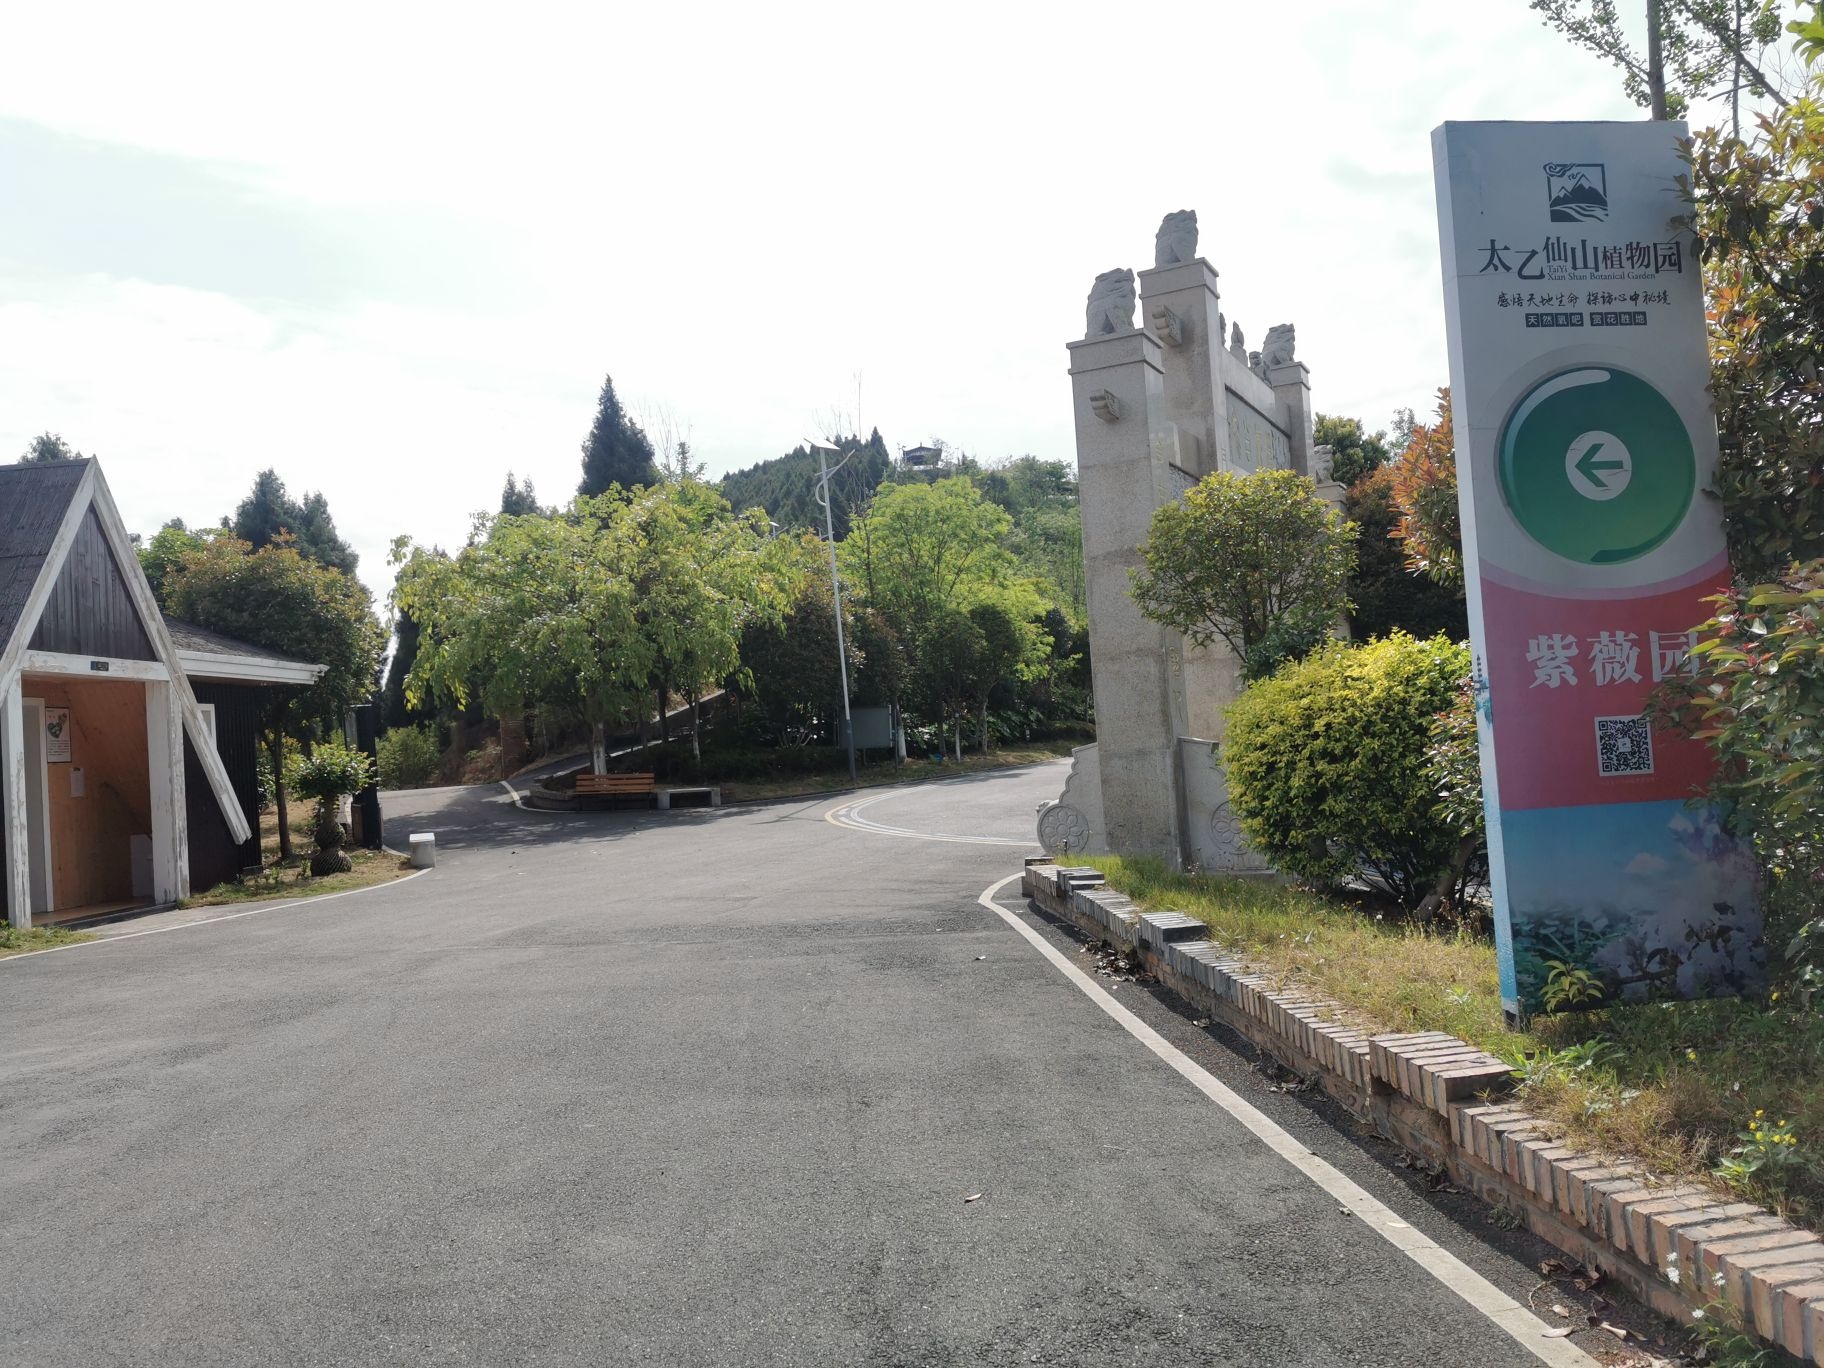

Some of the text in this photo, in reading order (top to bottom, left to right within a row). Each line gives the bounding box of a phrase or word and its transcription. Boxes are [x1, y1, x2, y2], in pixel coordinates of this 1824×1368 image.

[1478, 236, 1682, 280] 太乙仙山植物园
[1547, 264, 1568, 273] TaiYi
[1547, 271, 1656, 281] Xian Shan Botanical Garden
[1526, 630, 1700, 688] 紫薇园
